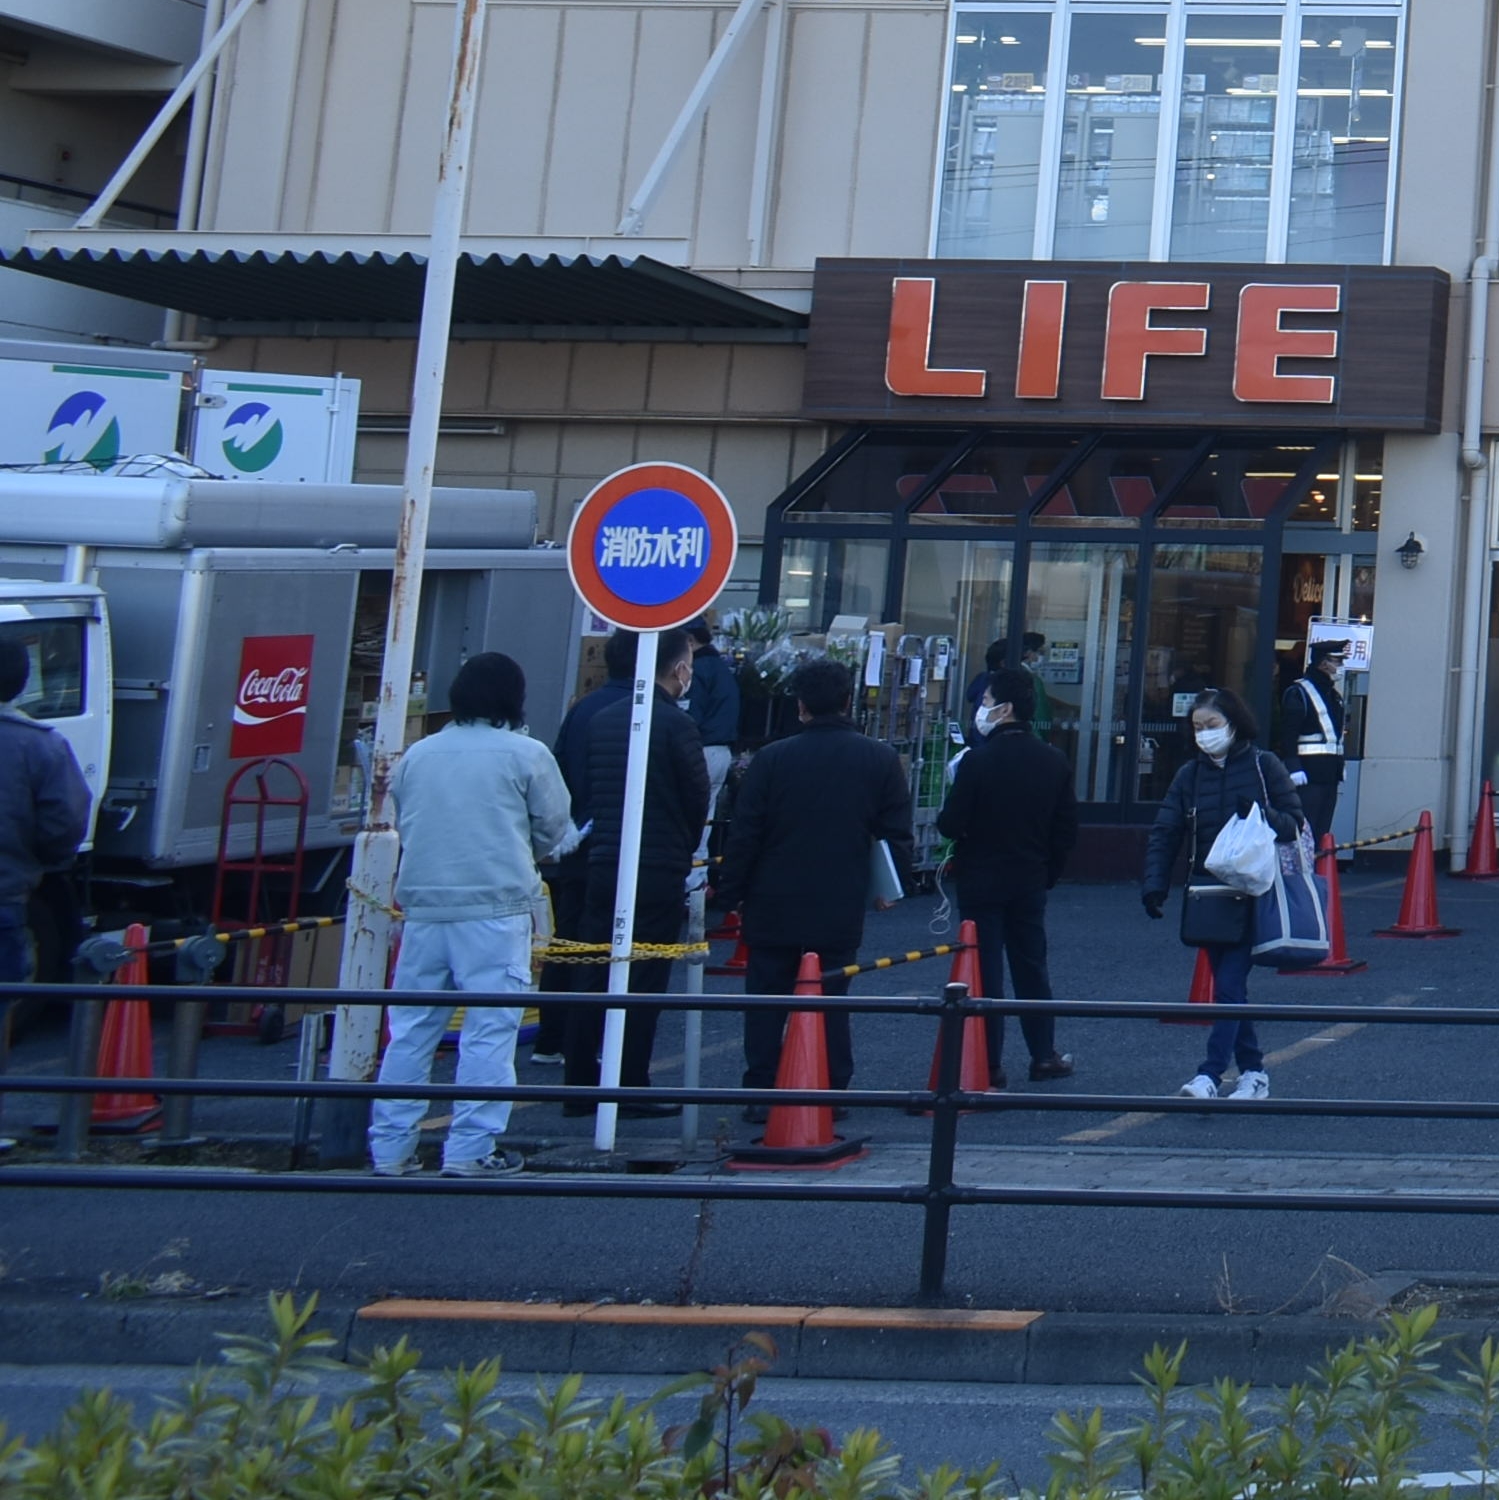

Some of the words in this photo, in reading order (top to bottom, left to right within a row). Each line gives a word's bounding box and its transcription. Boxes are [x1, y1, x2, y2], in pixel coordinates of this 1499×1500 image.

[884, 277, 1342, 404] LIFE
[600, 525, 704, 568] 消防水利
